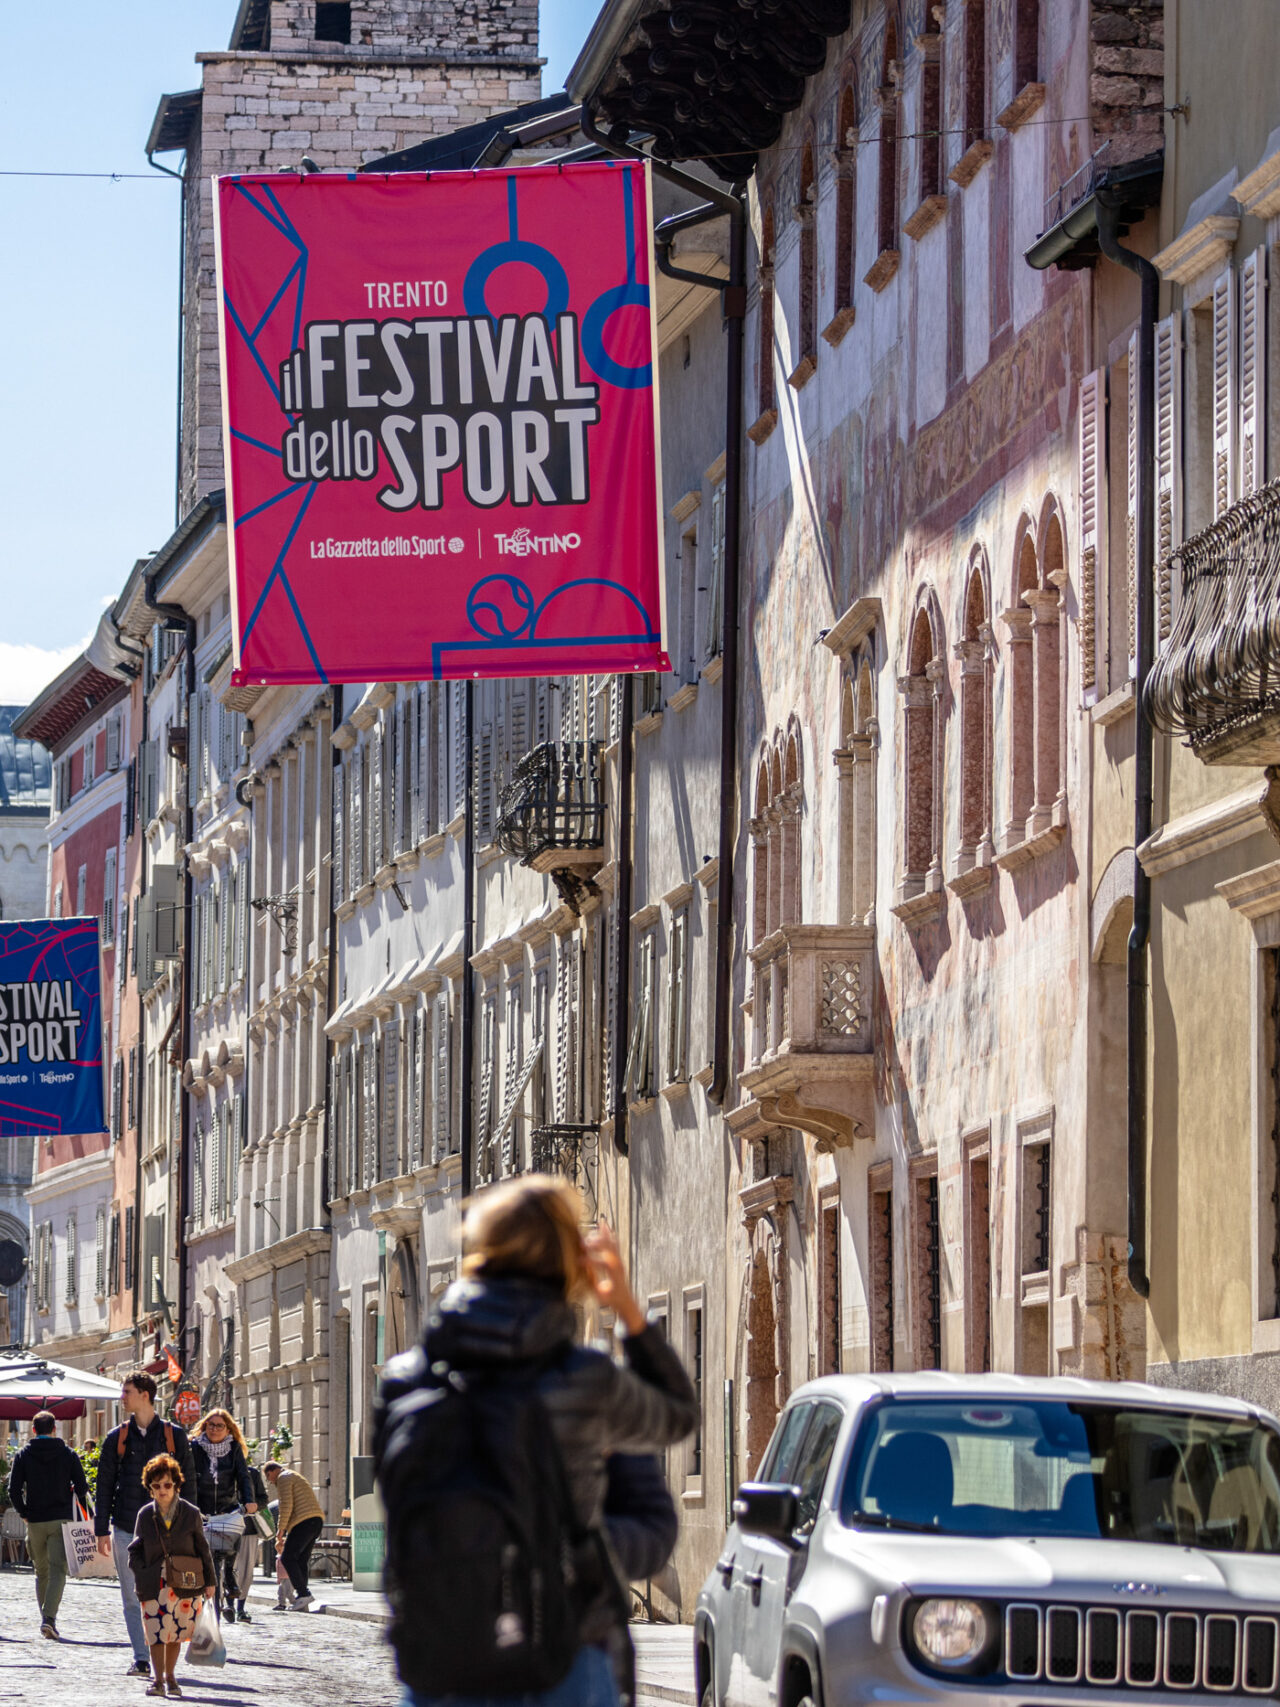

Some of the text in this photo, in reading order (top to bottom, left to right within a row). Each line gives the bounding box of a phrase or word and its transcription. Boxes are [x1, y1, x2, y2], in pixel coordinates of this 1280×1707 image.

[363, 280, 448, 309] TRENTO
[283, 316, 597, 410] il FESTIVAL
[286, 407, 598, 509] dello SPORT
[493, 530, 582, 558] TRENTINO
[71, 1528, 92, 1538] Gifts
[77, 1554, 95, 1565] give
